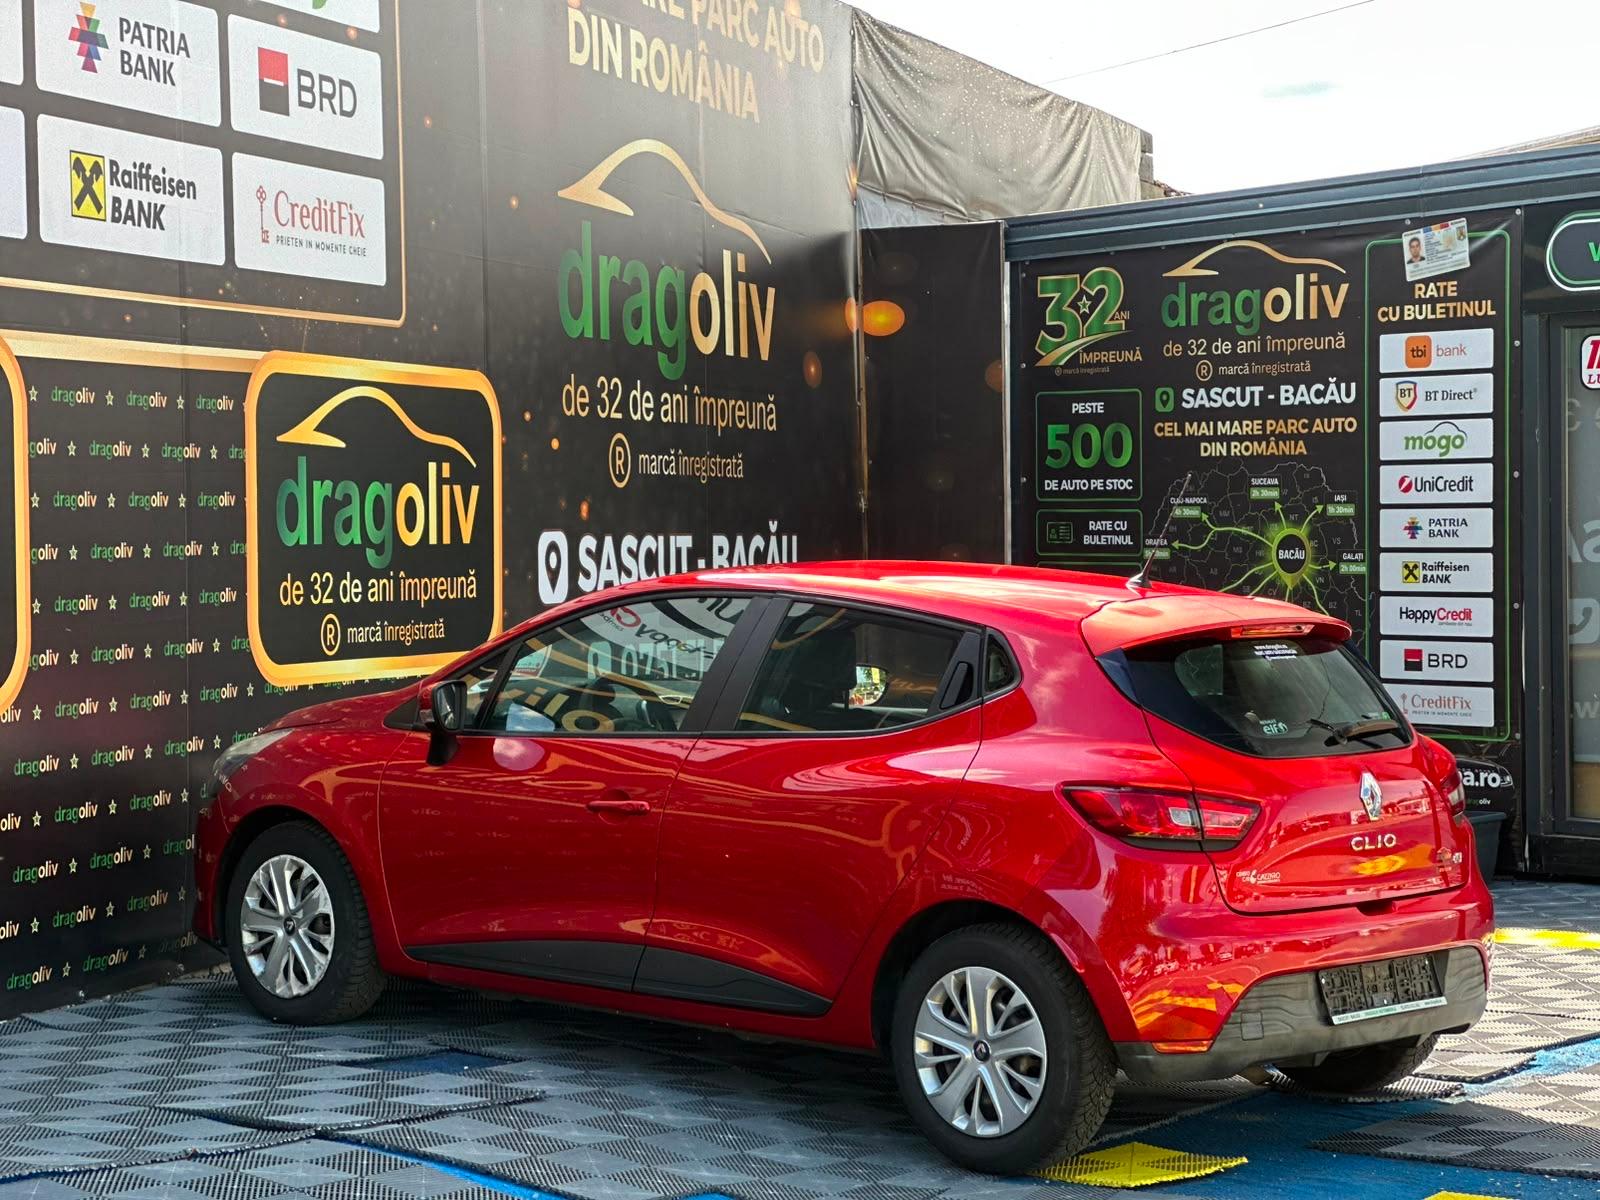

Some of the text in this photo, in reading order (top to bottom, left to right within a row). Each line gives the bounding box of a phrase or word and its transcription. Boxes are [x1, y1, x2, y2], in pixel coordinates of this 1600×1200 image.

[118, 16, 191, 59] PATRIA
[765, 6, 825, 73] AUTO
[120, 49, 176, 87] BANK
[568, 7, 760, 123] DIN ROMÂNIA
[297, 68, 358, 119] BRD
[109, 159, 197, 200] Raiffeisen
[110, 196, 166, 231] BANK
[274, 190, 366, 239] CreditFix
[276, 235, 367, 257] PRIETEN IN MOMENTE CHEIE
[558, 219, 776, 380] dragoliv
[1415, 281, 1458, 299] RATE
[1035, 266, 1124, 356] 32
[1113, 311, 1130, 320] ANI
[1161, 272, 1349, 336] dragoliv
[1377, 300, 1496, 322] CU BULETINUL
[1079, 346, 1142, 364] ÎMPREUNĂ
[1163, 331, 1346, 357] de 32 de ani împreună
[1410, 343, 1467, 359] tbi bank
[1218, 362, 1249, 376] marcă
[1251, 360, 1311, 377] înregistrată
[51, 386, 234, 413] dragoliv dragoliv dragoliv
[1181, 386, 1264, 409] SASCUT
[1279, 377, 1356, 406] BACĂU
[1399, 388, 1413, 398] BT
[1425, 390, 1439, 401] BT
[563, 374, 777, 437] de 32 de ani împreună
[1072, 402, 1105, 414] PESTE
[1154, 416, 1358, 437] CEL MAI MARE PARC AUTO
[29, 438, 201, 461] goliv dragoliv dragoliv
[1045, 422, 1133, 469] 500
[1200, 436, 1307, 457] DIN ROMÂNIA
[1404, 432, 1465, 457] mogo
[638, 449, 676, 476] marcă
[678, 449, 744, 484] înregistrată
[1044, 477, 1134, 492] DE AUTO PE STOC
[1251, 478, 1279, 486] SUCEAVA
[1415, 476, 1474, 493] UniCredit
[53, 491, 236, 511] dragoliv dragoliv dragoliv
[1334, 494, 1347, 502] IAȘI
[276, 456, 480, 569] dragoliv
[1429, 518, 1468, 528] PATRIA
[1089, 520, 1128, 533] RATE CU
[1429, 529, 1460, 538] BANK
[1083, 533, 1134, 546] BULETINUL
[31, 540, 203, 565] goliv dragoliv dragoliv
[578, 534, 693, 592] SASCUT
[712, 520, 798, 568] BACĂU
[1278, 549, 1305, 560] BACĂU
[1343, 553, 1364, 562] GALAȚI
[1422, 562, 1470, 572] Raiffeisen
[1422, 574, 1451, 584] BANK
[279, 569, 477, 608] de 32 de ani împreună
[54, 587, 237, 615] dragoliv dragoliv dragoliv
[1400, 607, 1472, 623] HappyCredit
[347, 622, 382, 643] marcă
[384, 618, 445, 646] înregistrată
[29, 649, 59, 671] goliv
[91, 643, 134, 665] dragoliv
[164, 638, 204, 659] dragoliv
[1428, 654, 1468, 669] BRD
[55, 698, 99, 719] dragoliv
[130, 691, 171, 711] dragoliv
[200, 683, 238, 703] dragoliv
[1411, 694, 1472, 710] CreditFix
[14, 736, 204, 777] dragoliv dragoliv dragoliv
[1458, 771, 1501, 788] a.ro
[0, 790, 171, 832] oliv dragoliv dragoliv
[1351, 833, 1397, 851] CLIO
[13, 834, 194, 884] dragoliv dragoliv dragol
[53, 905, 96, 928] dragoliv
[127, 890, 169, 912] dragoliv
[7, 967, 52, 990] dragoliv
[82, 949, 129, 972] dragoliv
